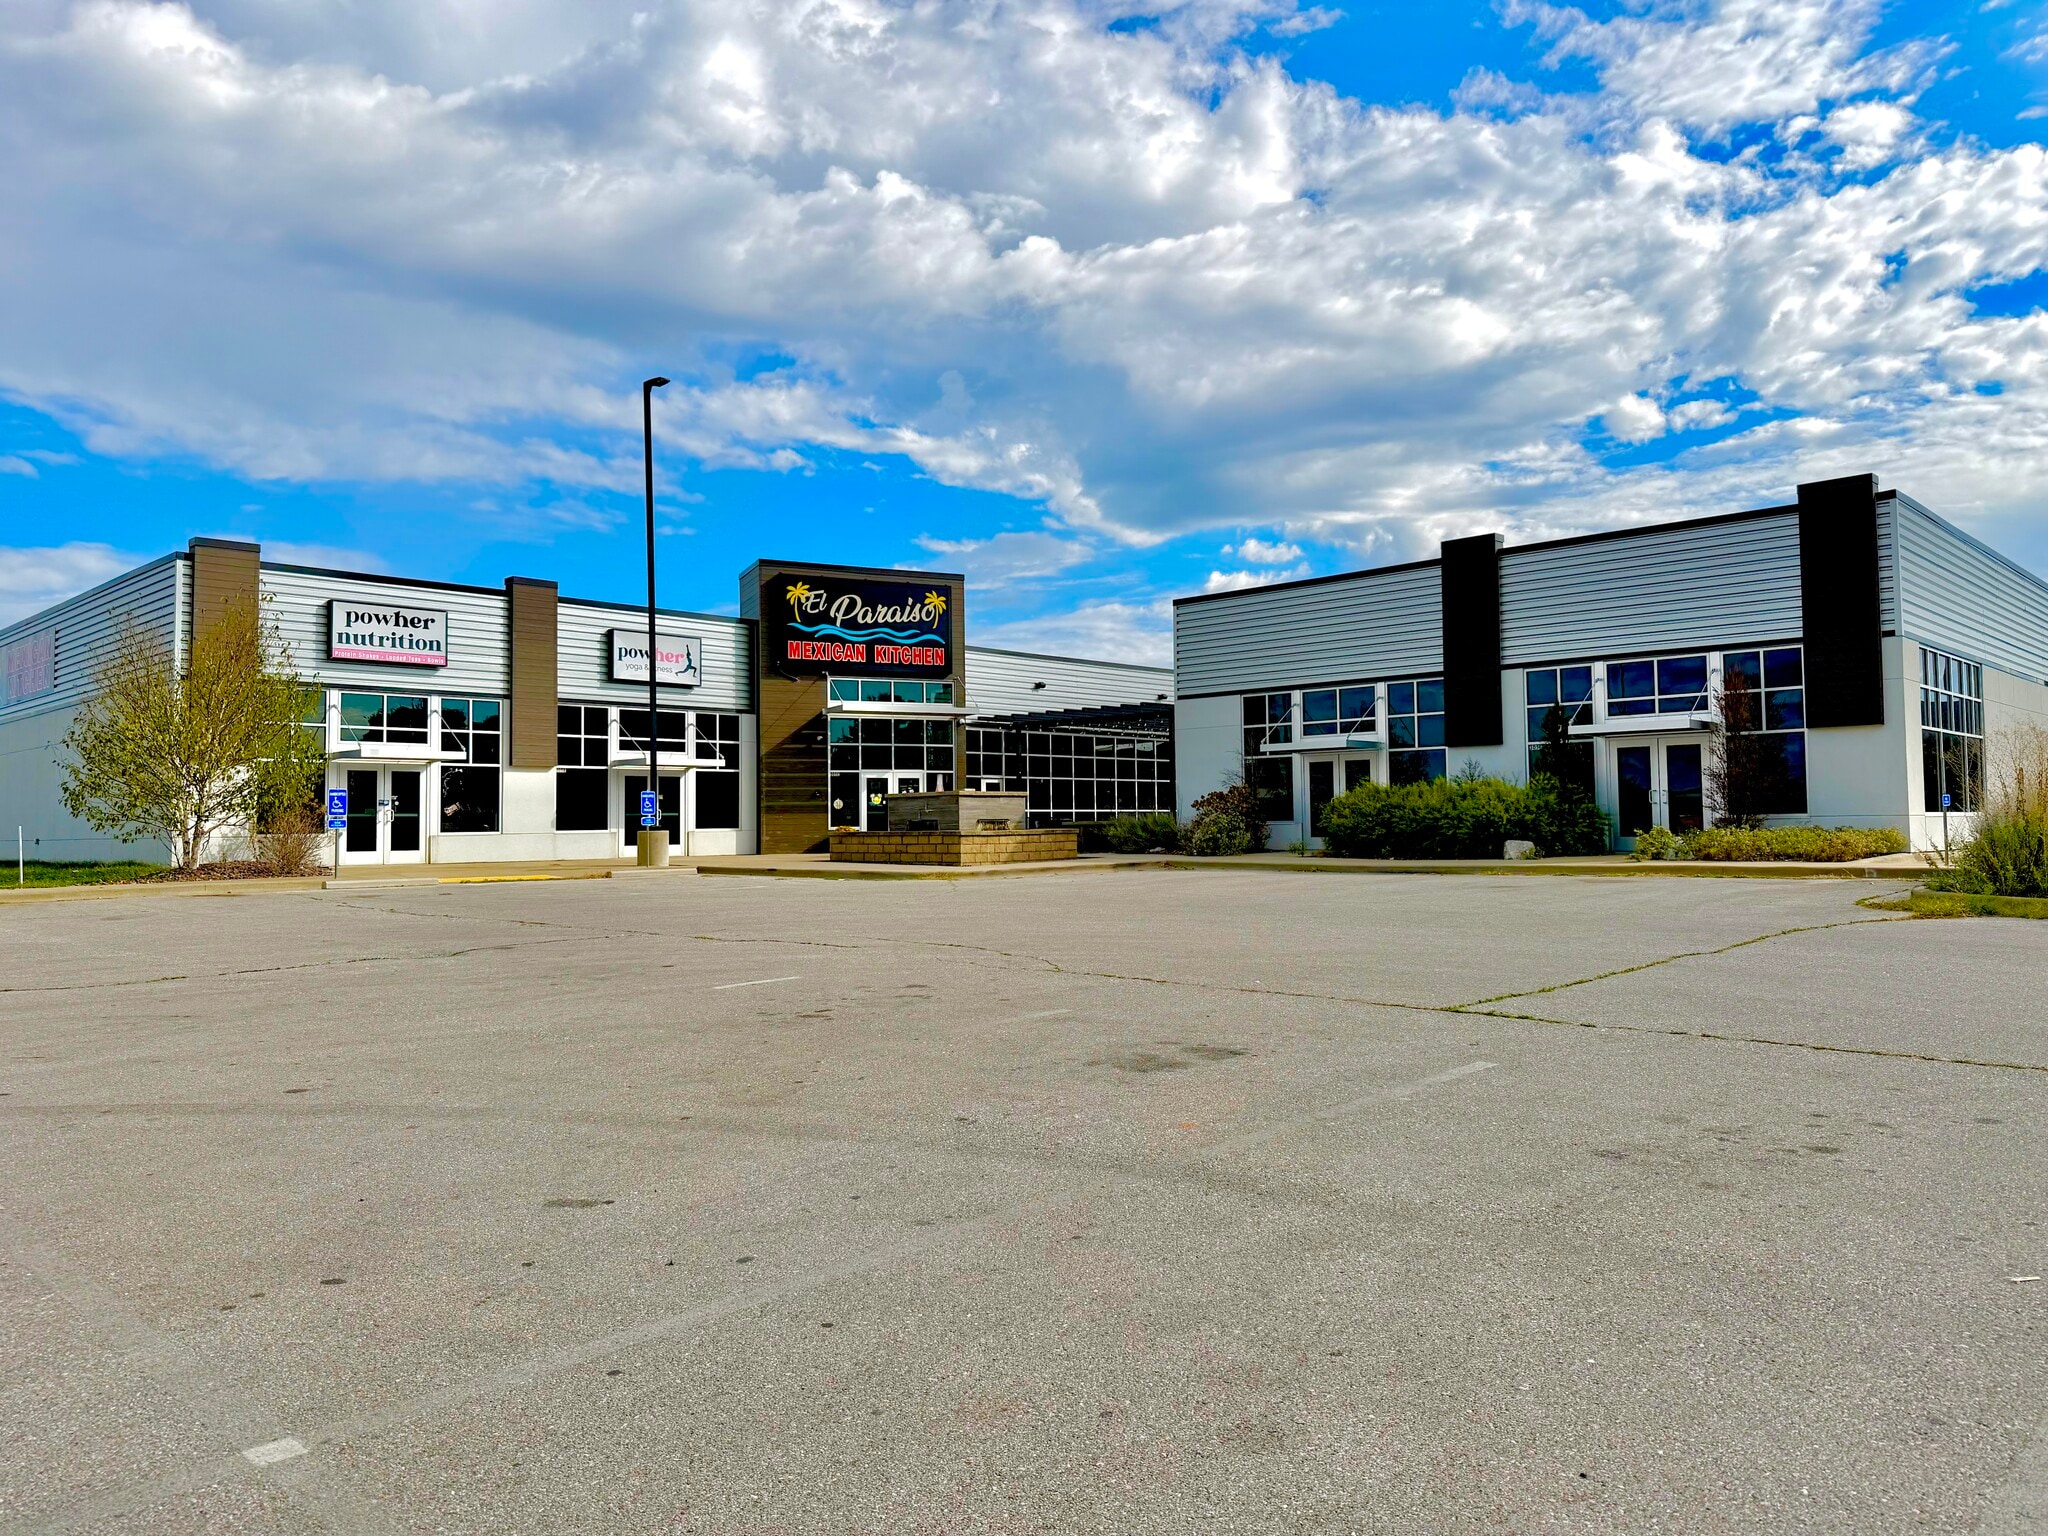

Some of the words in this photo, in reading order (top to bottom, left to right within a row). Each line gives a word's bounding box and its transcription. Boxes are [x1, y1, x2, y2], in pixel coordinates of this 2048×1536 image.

[345, 610, 436, 630] powher
[801, 590, 828, 614] El
[829, 594, 936, 627] Paraiso
[336, 631, 442, 652] nutrition
[787, 640, 866, 662] MEXICAN
[874, 645, 945, 666] KITCHEN
[625, 663, 643, 671] yoga
[7, 663, 50, 699] KITCHEN
